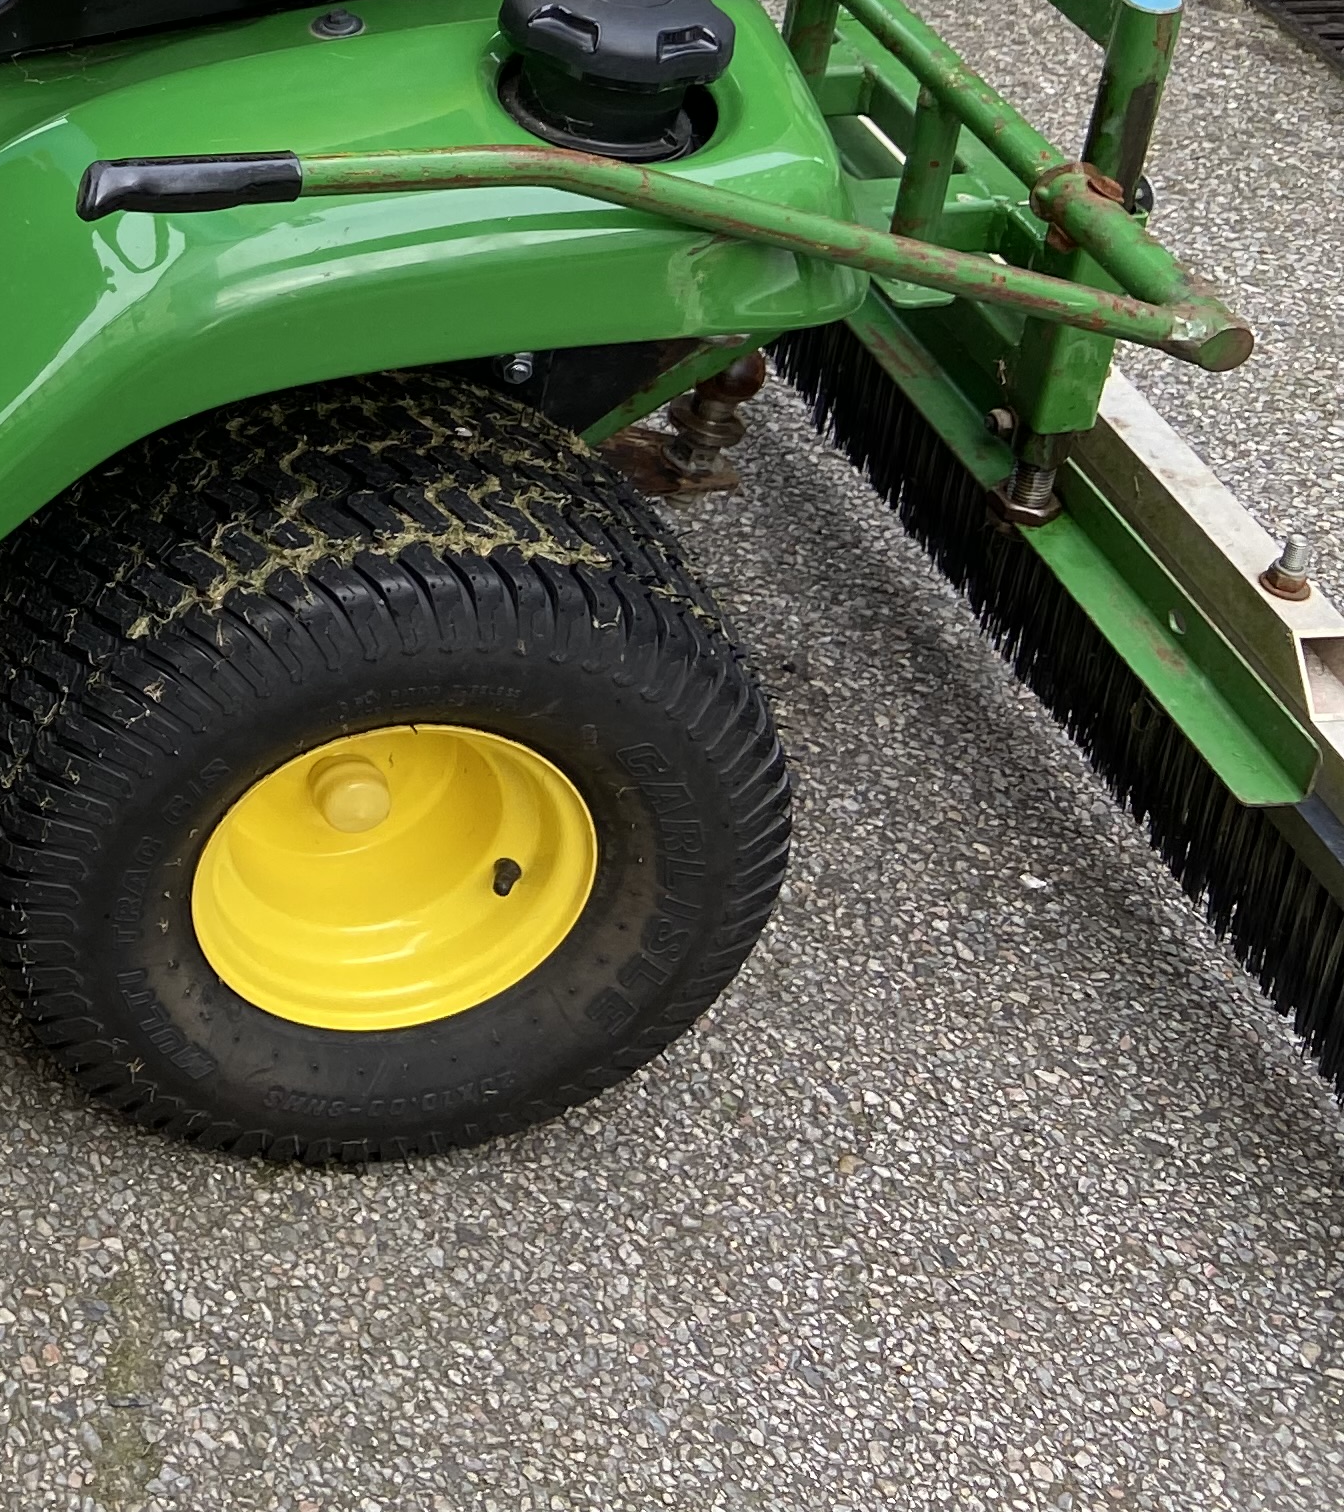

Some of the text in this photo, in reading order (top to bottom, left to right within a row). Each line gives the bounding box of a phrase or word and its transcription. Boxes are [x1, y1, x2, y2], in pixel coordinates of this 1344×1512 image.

[112, 835, 163, 947] TRAC
[584, 740, 707, 1037] CARLISLE
[115, 968, 216, 1080] MULTI
